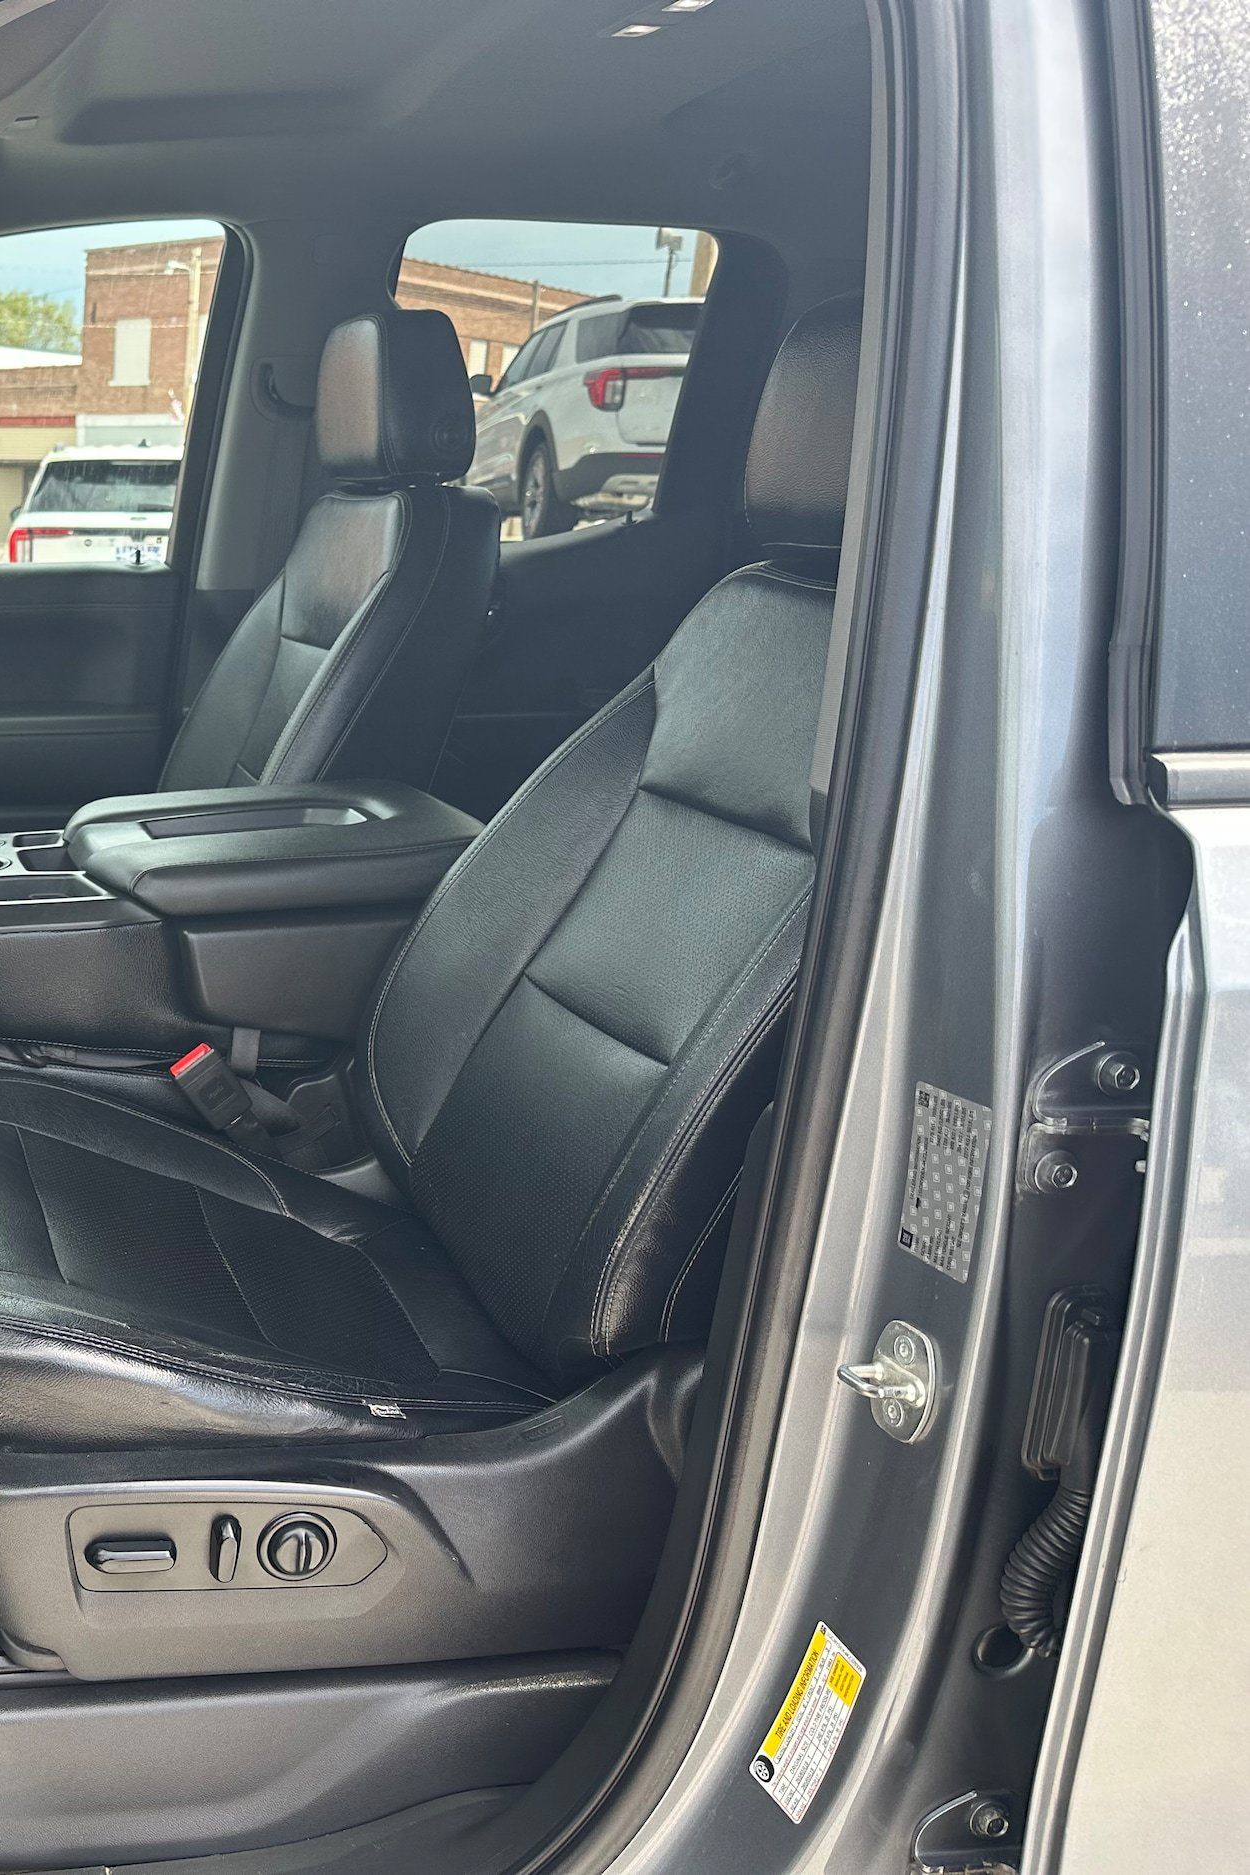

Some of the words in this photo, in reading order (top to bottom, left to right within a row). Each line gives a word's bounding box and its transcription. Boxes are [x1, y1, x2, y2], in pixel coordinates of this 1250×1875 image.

[798, 1647, 819, 1691] INFORMATION
[787, 1685, 804, 1715] LOADING
[774, 1721, 787, 1740] TIRE
[780, 1709, 792, 1728] AND
